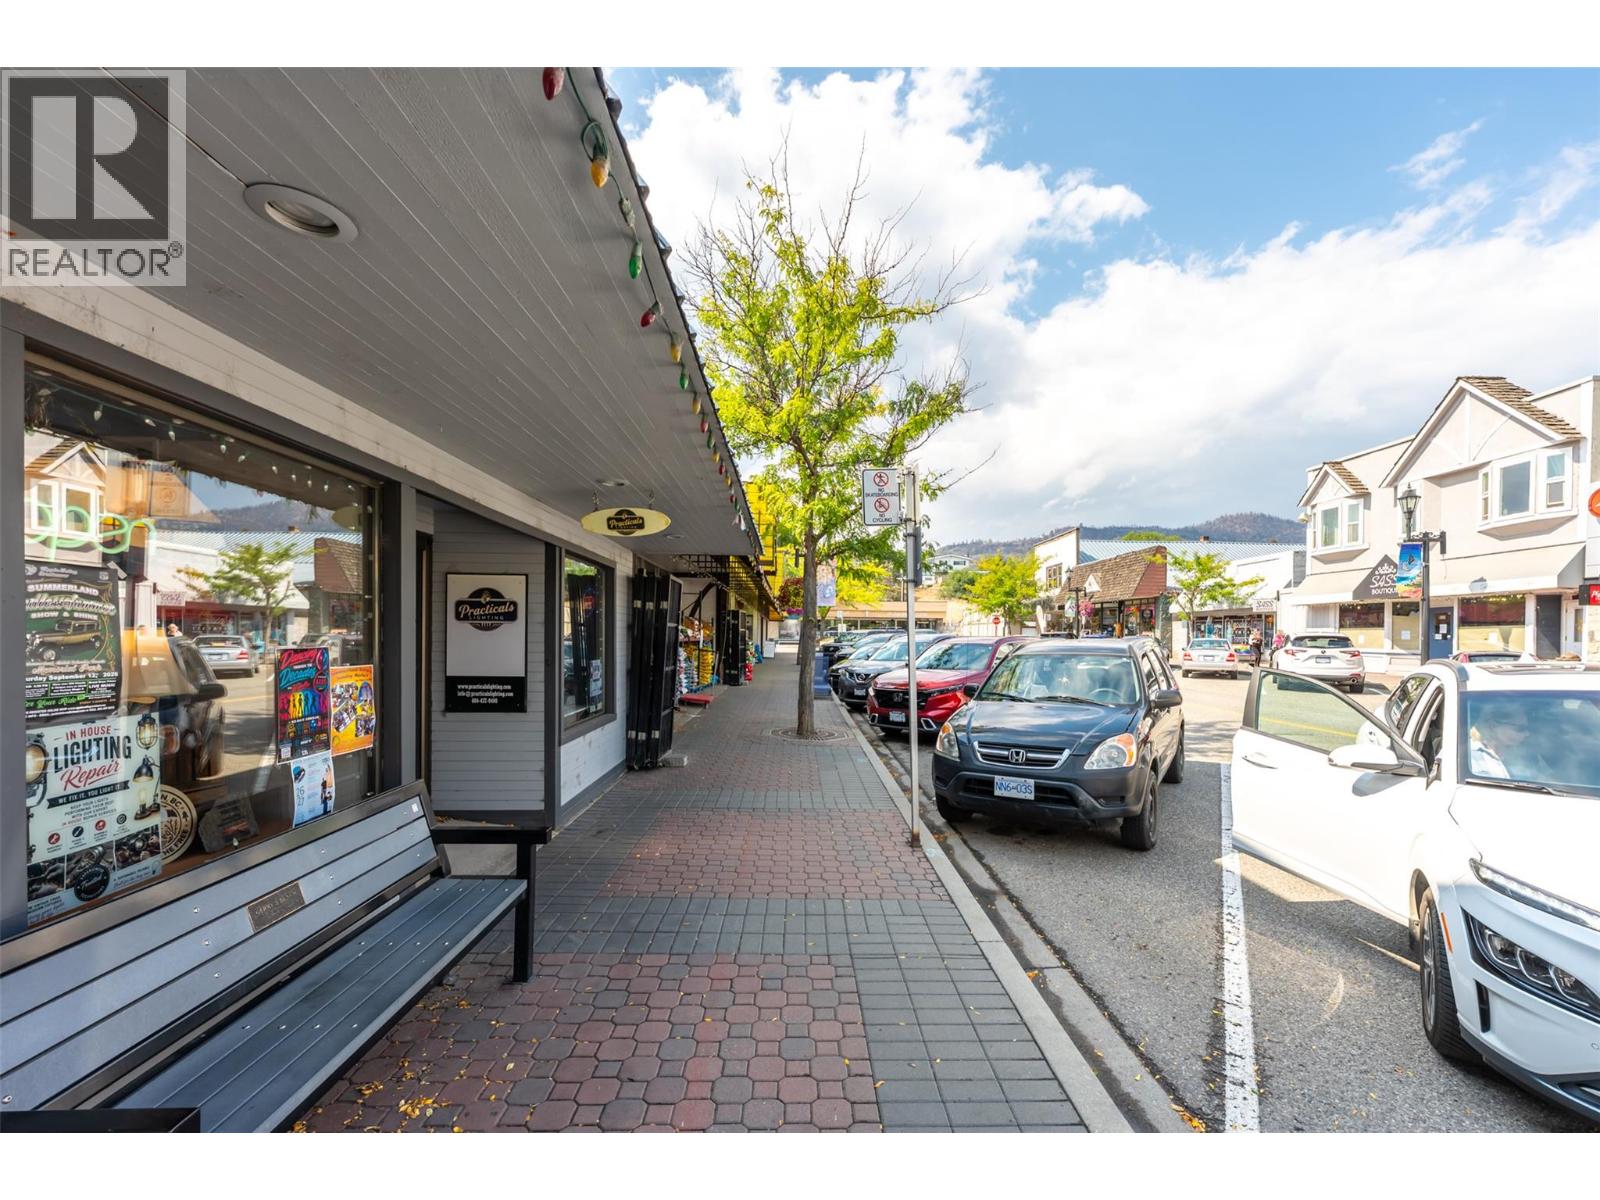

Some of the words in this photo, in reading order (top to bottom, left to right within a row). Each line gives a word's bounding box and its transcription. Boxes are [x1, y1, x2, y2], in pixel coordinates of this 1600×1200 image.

[608, 517, 643, 528] Practicals
[1370, 574, 1396, 588] SAS
[26, 584, 100, 596] SUMMERLAND
[73, 612, 98, 620] SHINE
[458, 602, 515, 618] Practicals
[48, 674, 86, 682] September
[66, 730, 76, 740] IN
[80, 726, 112, 738] HOUSE
[54, 735, 132, 774] LIGHTING
[60, 760, 120, 792] Repair
[100, 786, 114, 794] LIGHT
